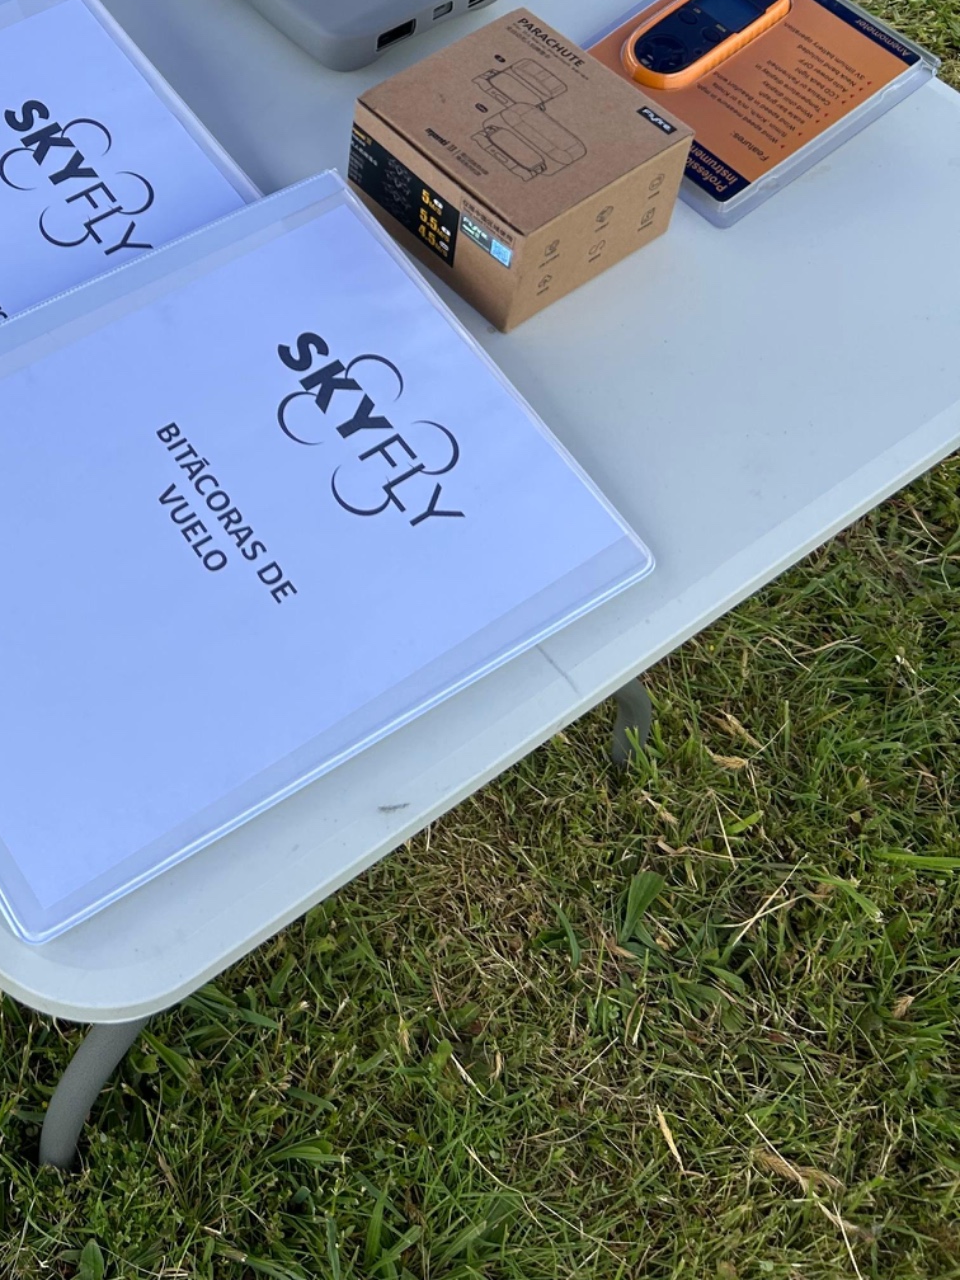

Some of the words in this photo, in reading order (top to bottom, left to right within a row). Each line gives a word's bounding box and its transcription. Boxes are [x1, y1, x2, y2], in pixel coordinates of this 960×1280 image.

[517, 17, 586, 67] PARACHUTE
[855, 18, 910, 57] Anemometer
[4, 100, 154, 256] SKYFLY
[690, 141, 739, 184] Instrumen
[276, 331, 466, 527] SKYFLY
[156, 483, 229, 573] VUELO
[256, 560, 298, 605] DE
